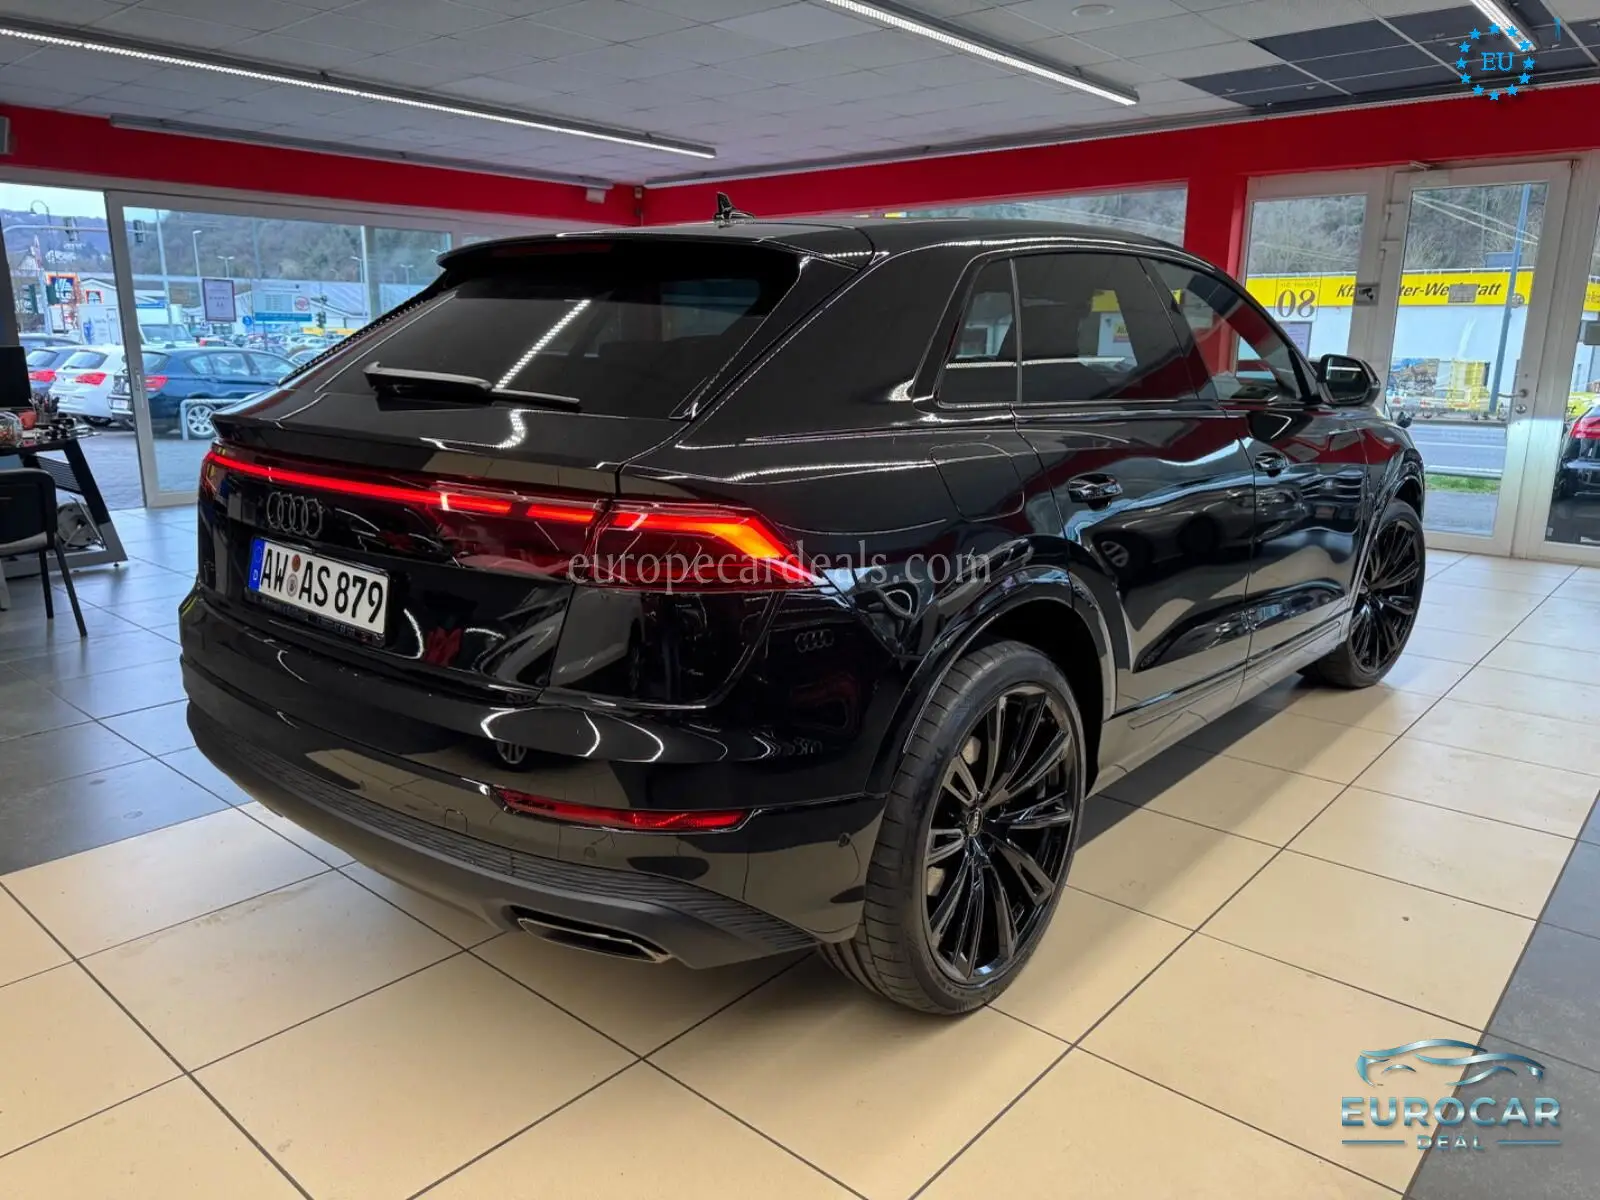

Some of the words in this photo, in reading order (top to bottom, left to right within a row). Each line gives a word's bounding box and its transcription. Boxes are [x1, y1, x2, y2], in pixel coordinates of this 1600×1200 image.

[260, 548, 289, 593] AW
[298, 560, 331, 607] AS
[334, 571, 383, 624] 879
